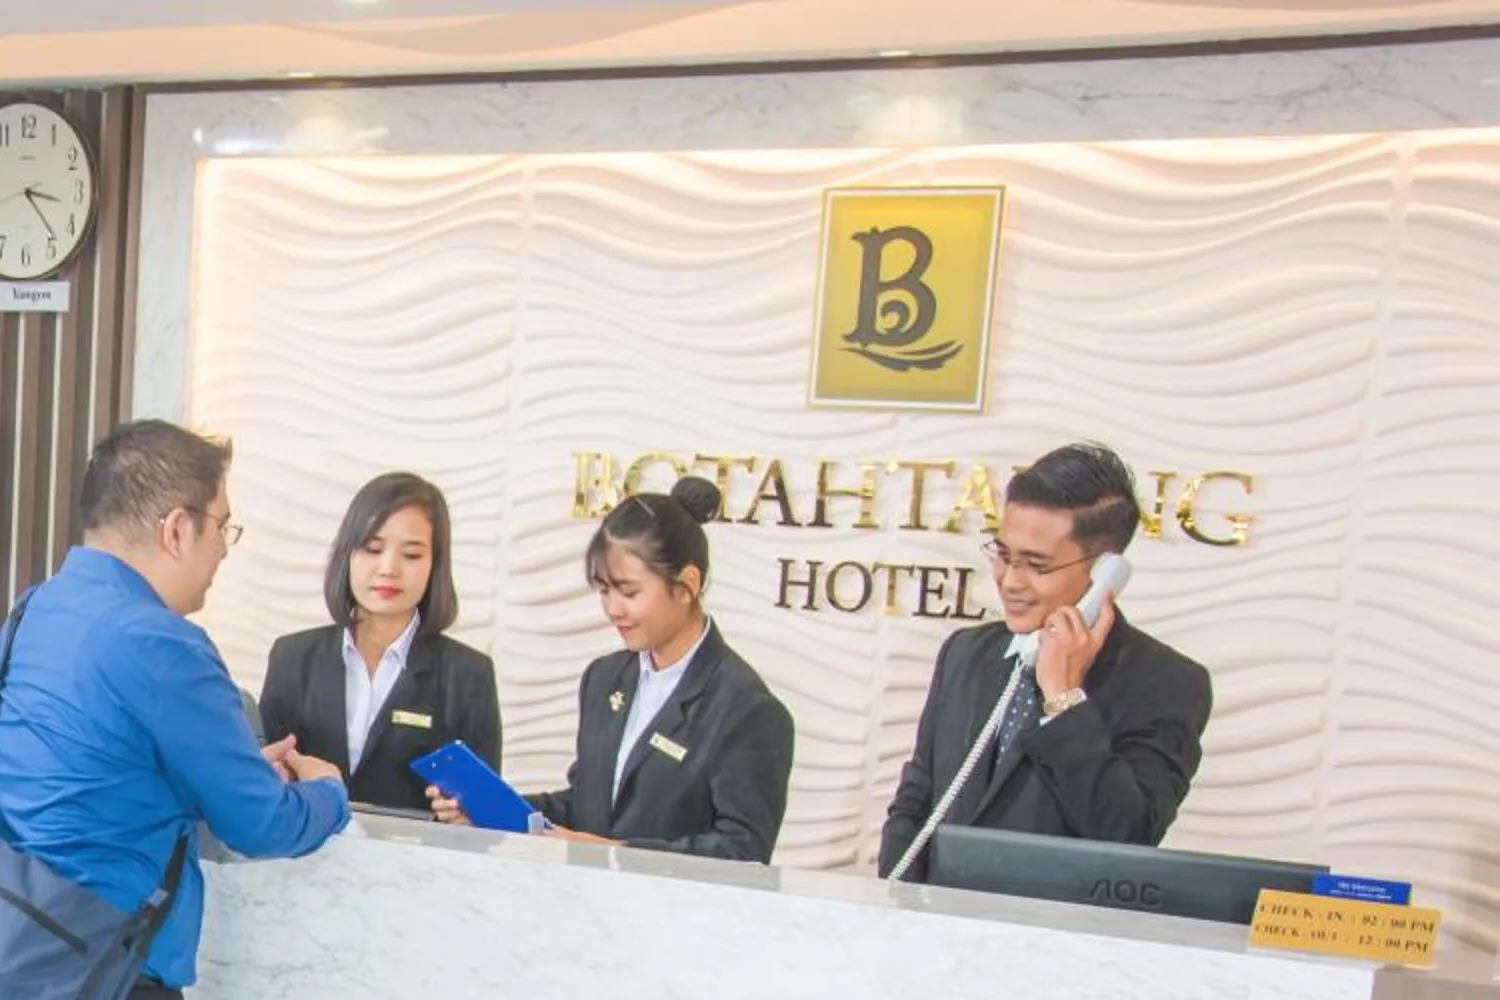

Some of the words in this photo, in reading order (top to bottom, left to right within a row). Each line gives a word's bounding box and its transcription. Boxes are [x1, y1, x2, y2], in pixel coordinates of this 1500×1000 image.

[21, 115, 37, 139] 12
[52, 123, 57, 147] 1
[67, 147, 78, 171] 2
[74, 180, 85, 204] 3
[66, 213, 75, 237] 4
[21, 244, 31, 268] 6
[46, 237, 57, 260] 5
[841, 226, 937, 348] B
[572, 451, 1255, 547] BOTAHTAG
[774, 557, 986, 620] HOTEL
[1090, 879, 1160, 906] AOC
[1259, 903, 1314, 921] CHECK
[1326, 911, 1343, 922] IN
[1390, 917, 1407, 929] 00
[1409, 919, 1436, 934] PM
[1254, 924, 1300, 938] CHECK
[1311, 930, 1339, 943] OUT
[1358, 934, 1375, 947] 12
[1384, 938, 1401, 949] 00
[1404, 940, 1429, 953] PM
